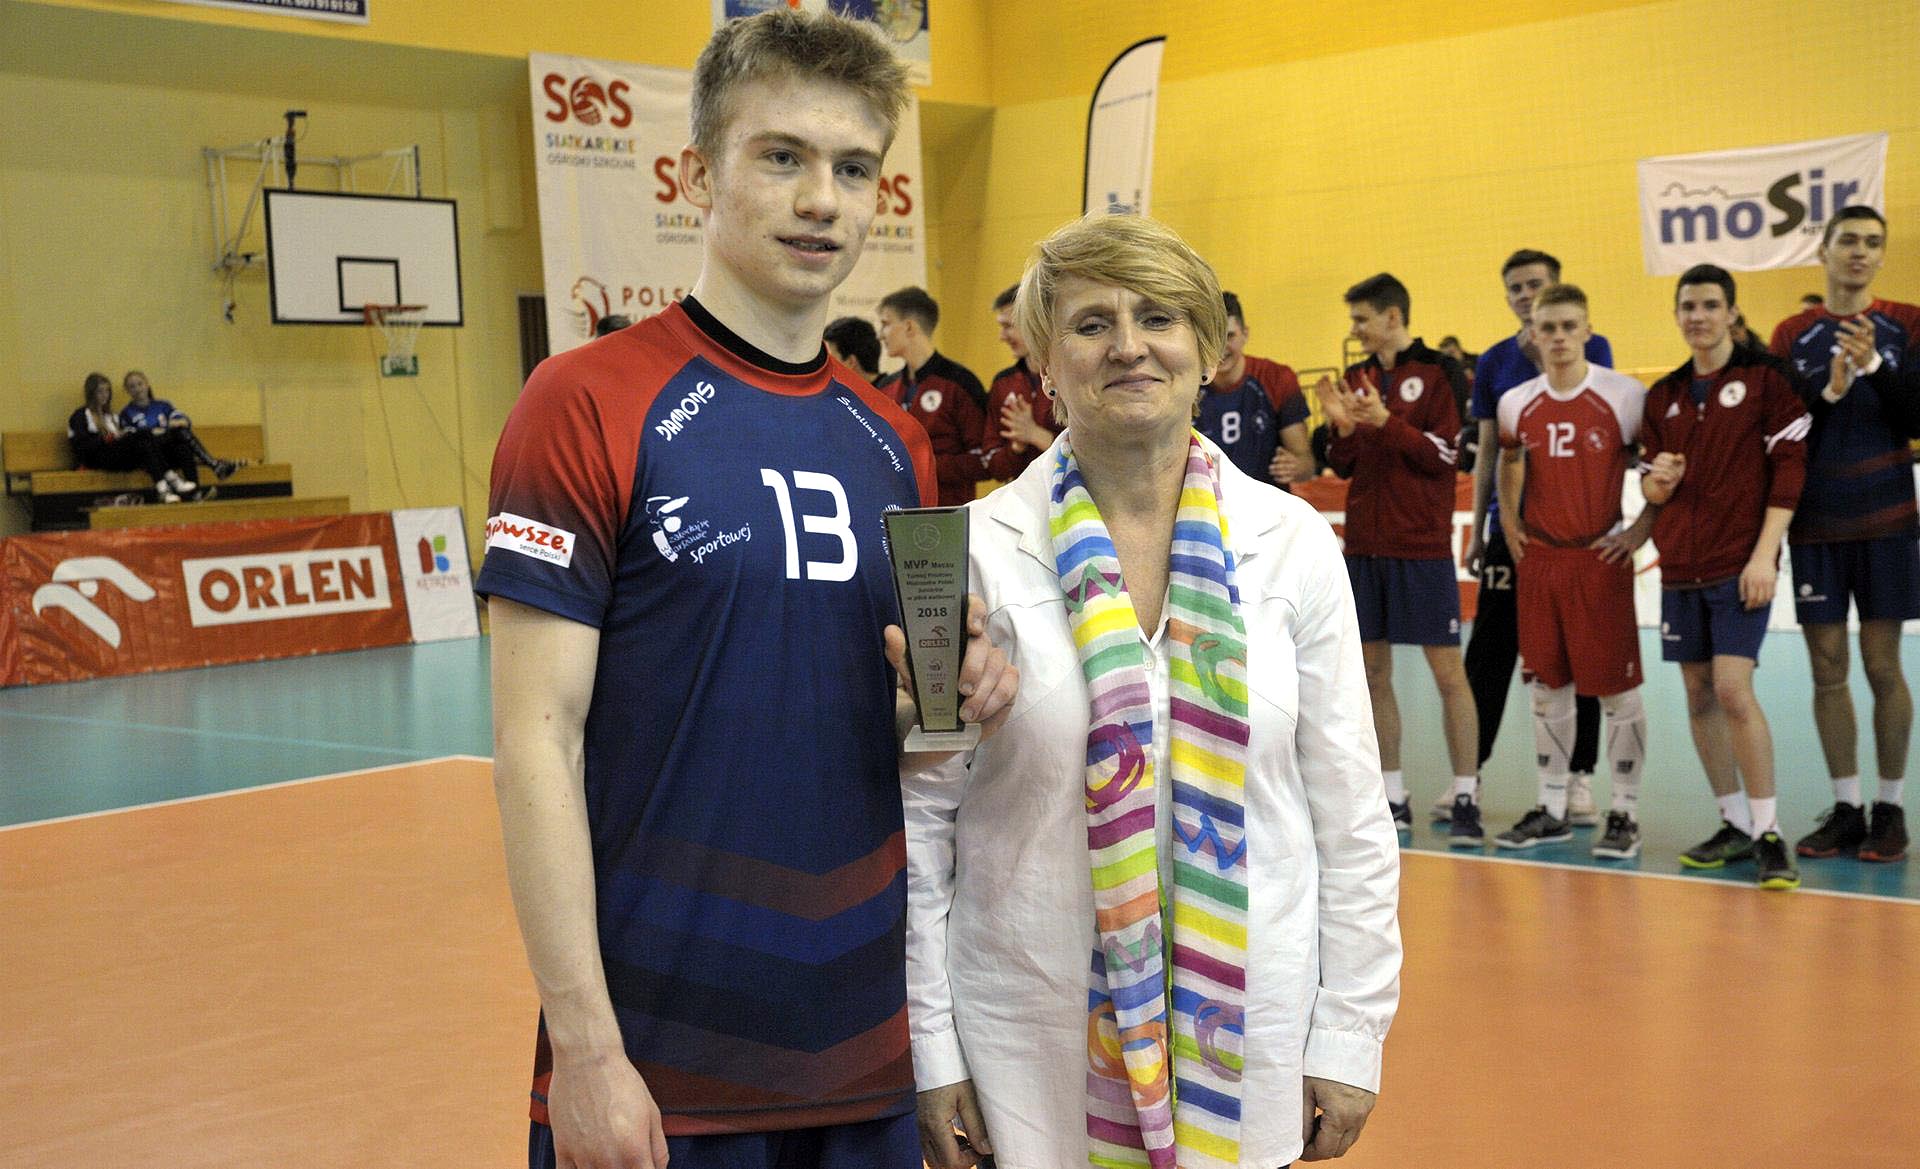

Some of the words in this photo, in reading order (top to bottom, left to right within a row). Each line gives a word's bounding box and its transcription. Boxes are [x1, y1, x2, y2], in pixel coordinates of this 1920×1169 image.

[546, 132, 636, 154] SIATKARSKIE
[1221, 411, 1242, 445] 8
[1546, 421, 1577, 458] 12
[759, 467, 859, 583] 13
[689, 522, 752, 565] sportowej
[903, 559, 928, 570] MVP
[1484, 564, 1512, 590] 12
[199, 557, 376, 614] ORLEN
[917, 606, 948, 618] 2018
